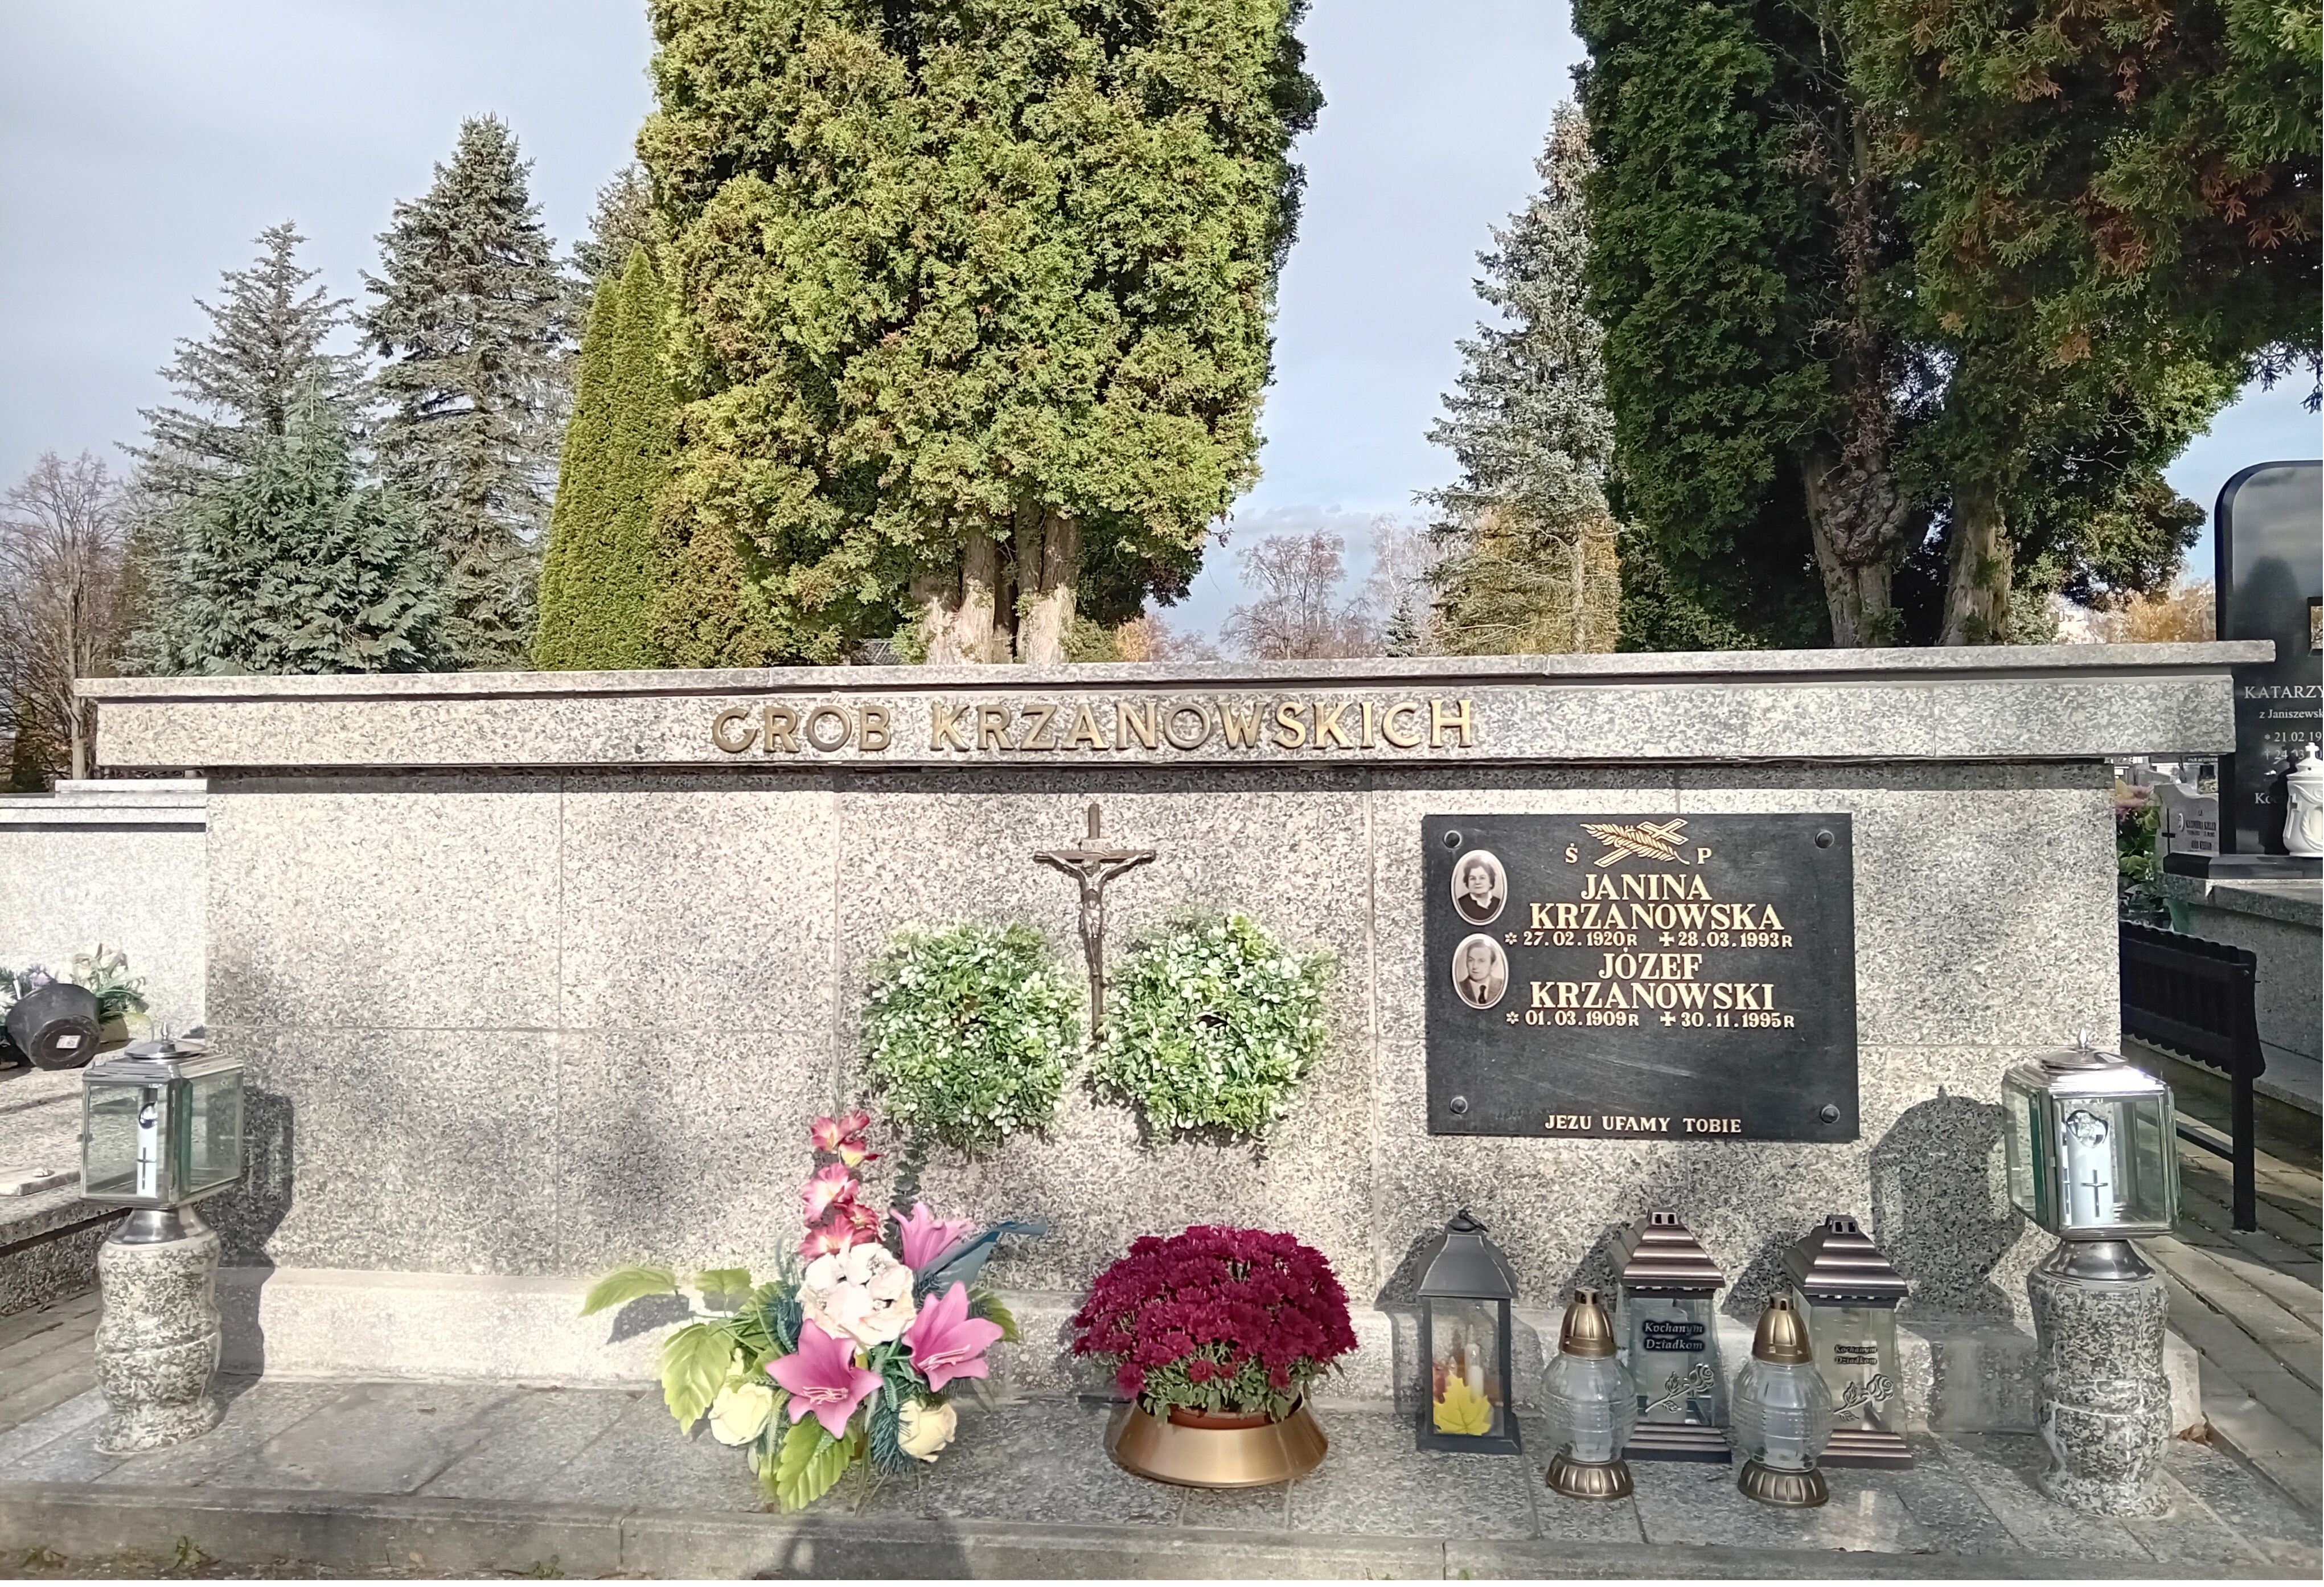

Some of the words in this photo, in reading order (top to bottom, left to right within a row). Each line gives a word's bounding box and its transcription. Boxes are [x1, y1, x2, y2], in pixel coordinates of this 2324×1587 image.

[930, 699, 1473, 753] KRZANOWSKICH
[1697, 847, 1712, 864] P
[1580, 874, 1713, 900] JANINA
[1529, 903, 1785, 930] KRZANOWSKA
[1598, 947, 1703, 980] JÓZEF
[1530, 981, 1775, 1010] KRZANOWSKI
[1545, 1114, 1592, 1130] JEZU
[1602, 1116, 1671, 1132] UFAMY
[1682, 1118, 1742, 1134] TOBIE
[1644, 1322, 1703, 1336] Kochanym
[1646, 1339, 1703, 1350] Dziadkom
[1835, 1346, 1877, 1355] Kochanym
